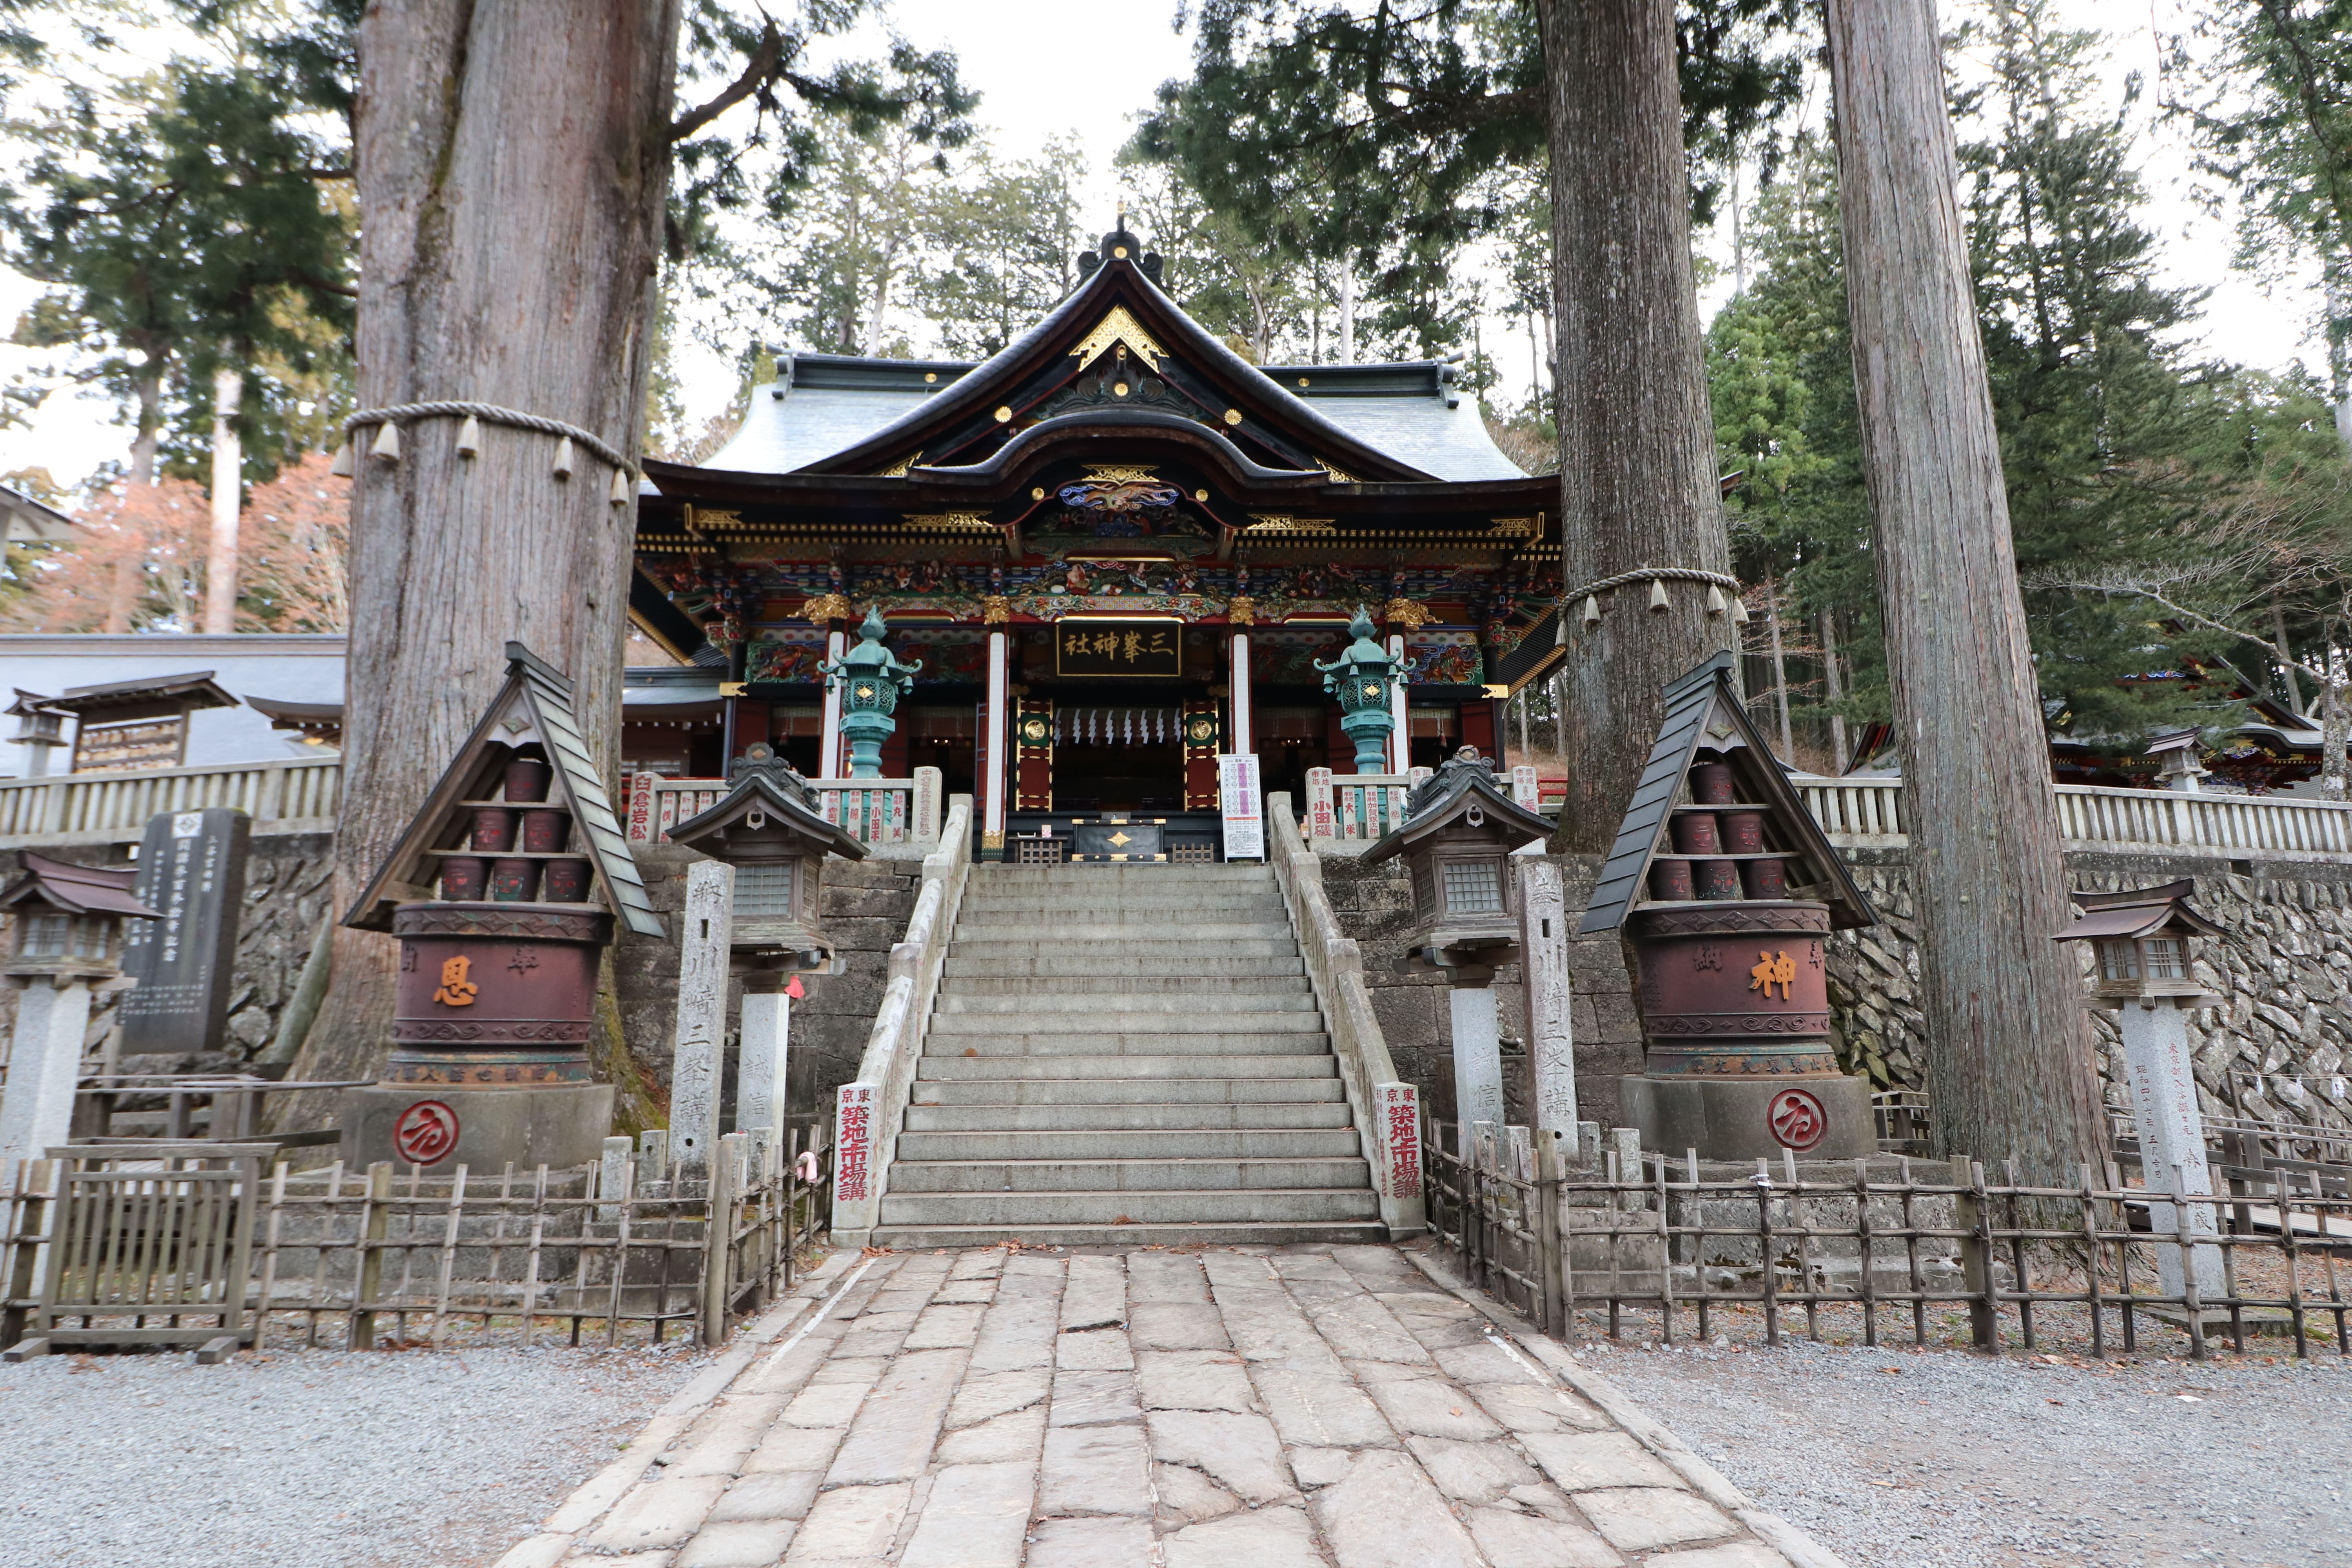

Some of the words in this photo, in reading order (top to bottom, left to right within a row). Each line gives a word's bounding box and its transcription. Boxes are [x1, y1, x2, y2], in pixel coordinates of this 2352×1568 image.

[432, 955, 478, 1007] 恩
[1748, 950, 1797, 1001] 神
[838, 1105, 870, 1201] 築地市場講
[1388, 1104, 1421, 1199] 築地市場講
